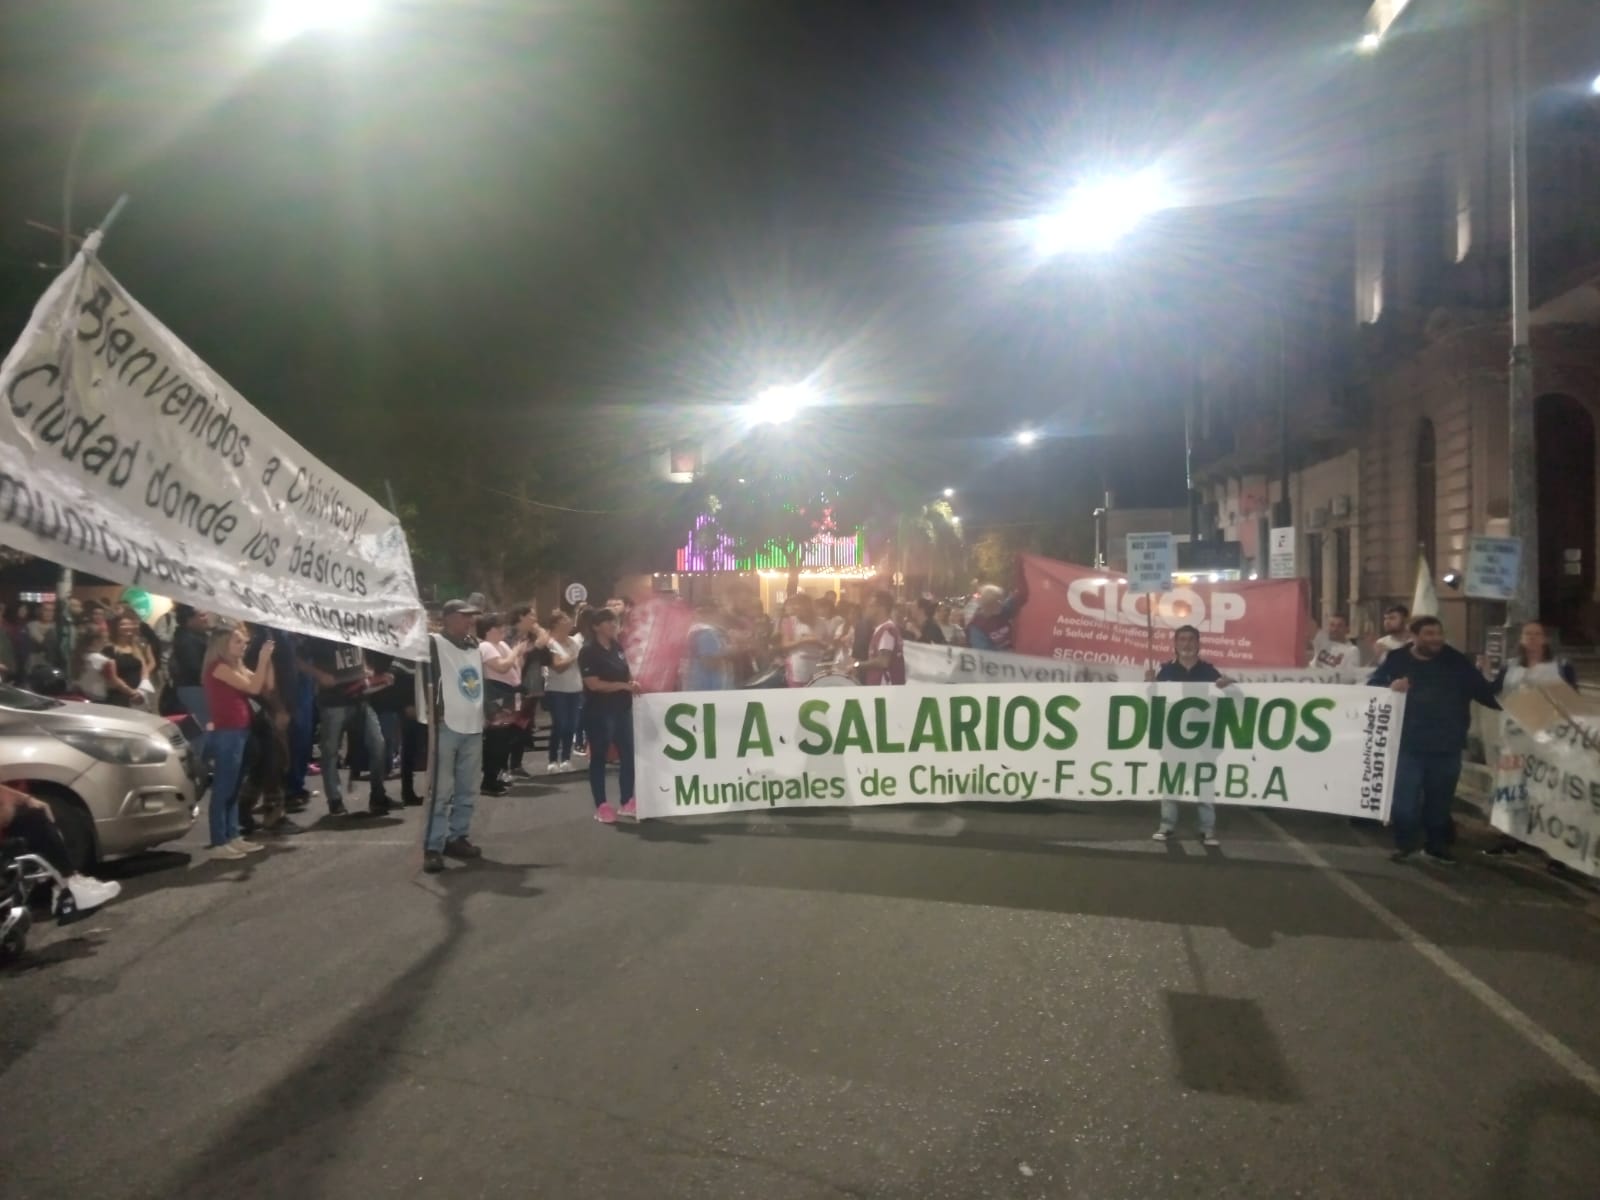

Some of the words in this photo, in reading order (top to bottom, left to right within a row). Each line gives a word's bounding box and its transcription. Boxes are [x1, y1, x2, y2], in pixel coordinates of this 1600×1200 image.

[7, 364, 141, 487] Ciudad
[145, 463, 238, 544] donde
[242, 520, 281, 567] los
[288, 536, 368, 596] básicos
[262, 457, 281, 487] a
[1065, 627, 1094, 640] Salud
[1053, 647, 1136, 666] SECCIONAL
[663, 702, 716, 761] SI
[736, 701, 775, 757] A
[798, 695, 1081, 755] SALARIOS
[1107, 694, 1337, 753] DIGNOS
[674, 771, 846, 807] Municipales
[859, 768, 897, 797] de
[1360, 786, 1371, 809] CG
